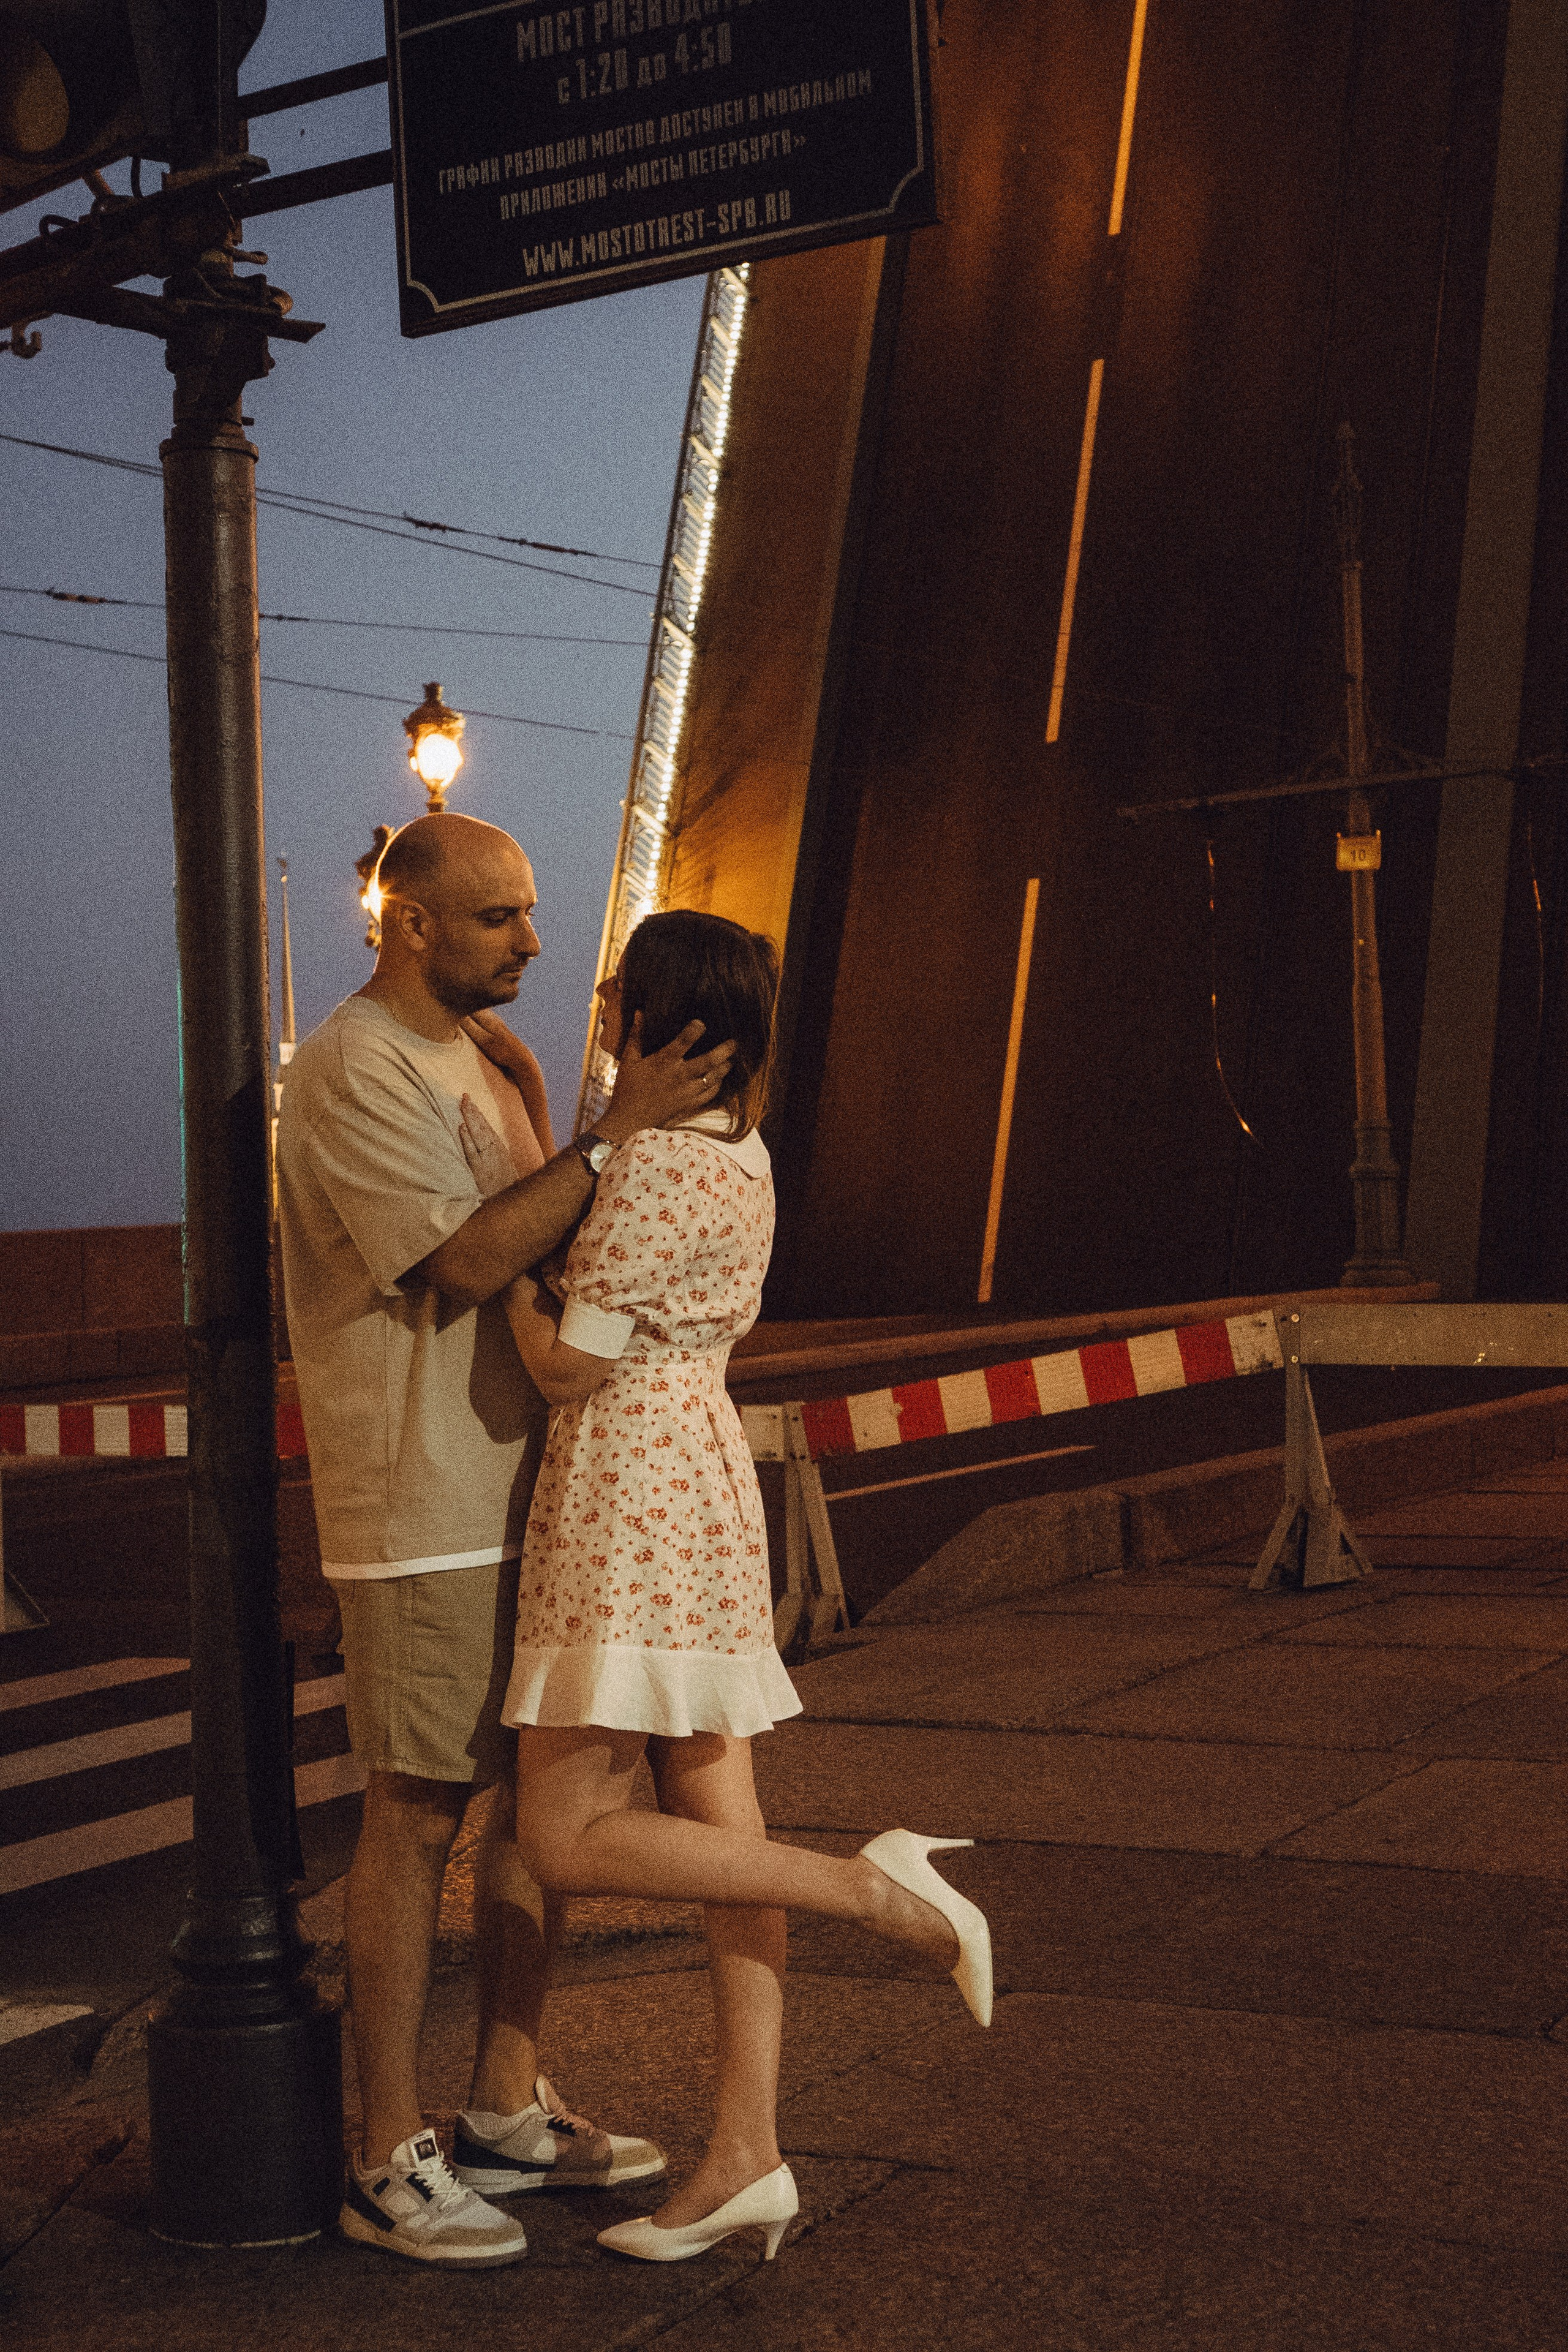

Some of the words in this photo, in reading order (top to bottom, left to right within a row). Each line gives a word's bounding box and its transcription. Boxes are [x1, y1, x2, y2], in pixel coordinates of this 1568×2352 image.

[517, 6, 586, 62] МОСТ
[576, 48, 629, 100] 1:20
[674, 21, 732, 74] 4:50
[439, 157, 500, 195] ГРАФИК
[504, 136, 587, 179] РАЗВОДКИ
[591, 119, 655, 159] МОСТОВ
[660, 98, 744, 145] ДОСТУПЕН
[764, 69, 872, 118] МОБИЛЬНОМ
[500, 172, 608, 221] ПРИЛОЖЕНИИ
[612, 154, 684, 192] «МОСТЫ
[688, 129, 807, 176] ПЕТЕРБУРГА»
[522, 189, 792, 277] WWW.MOSTOTREST-SPB.RU
